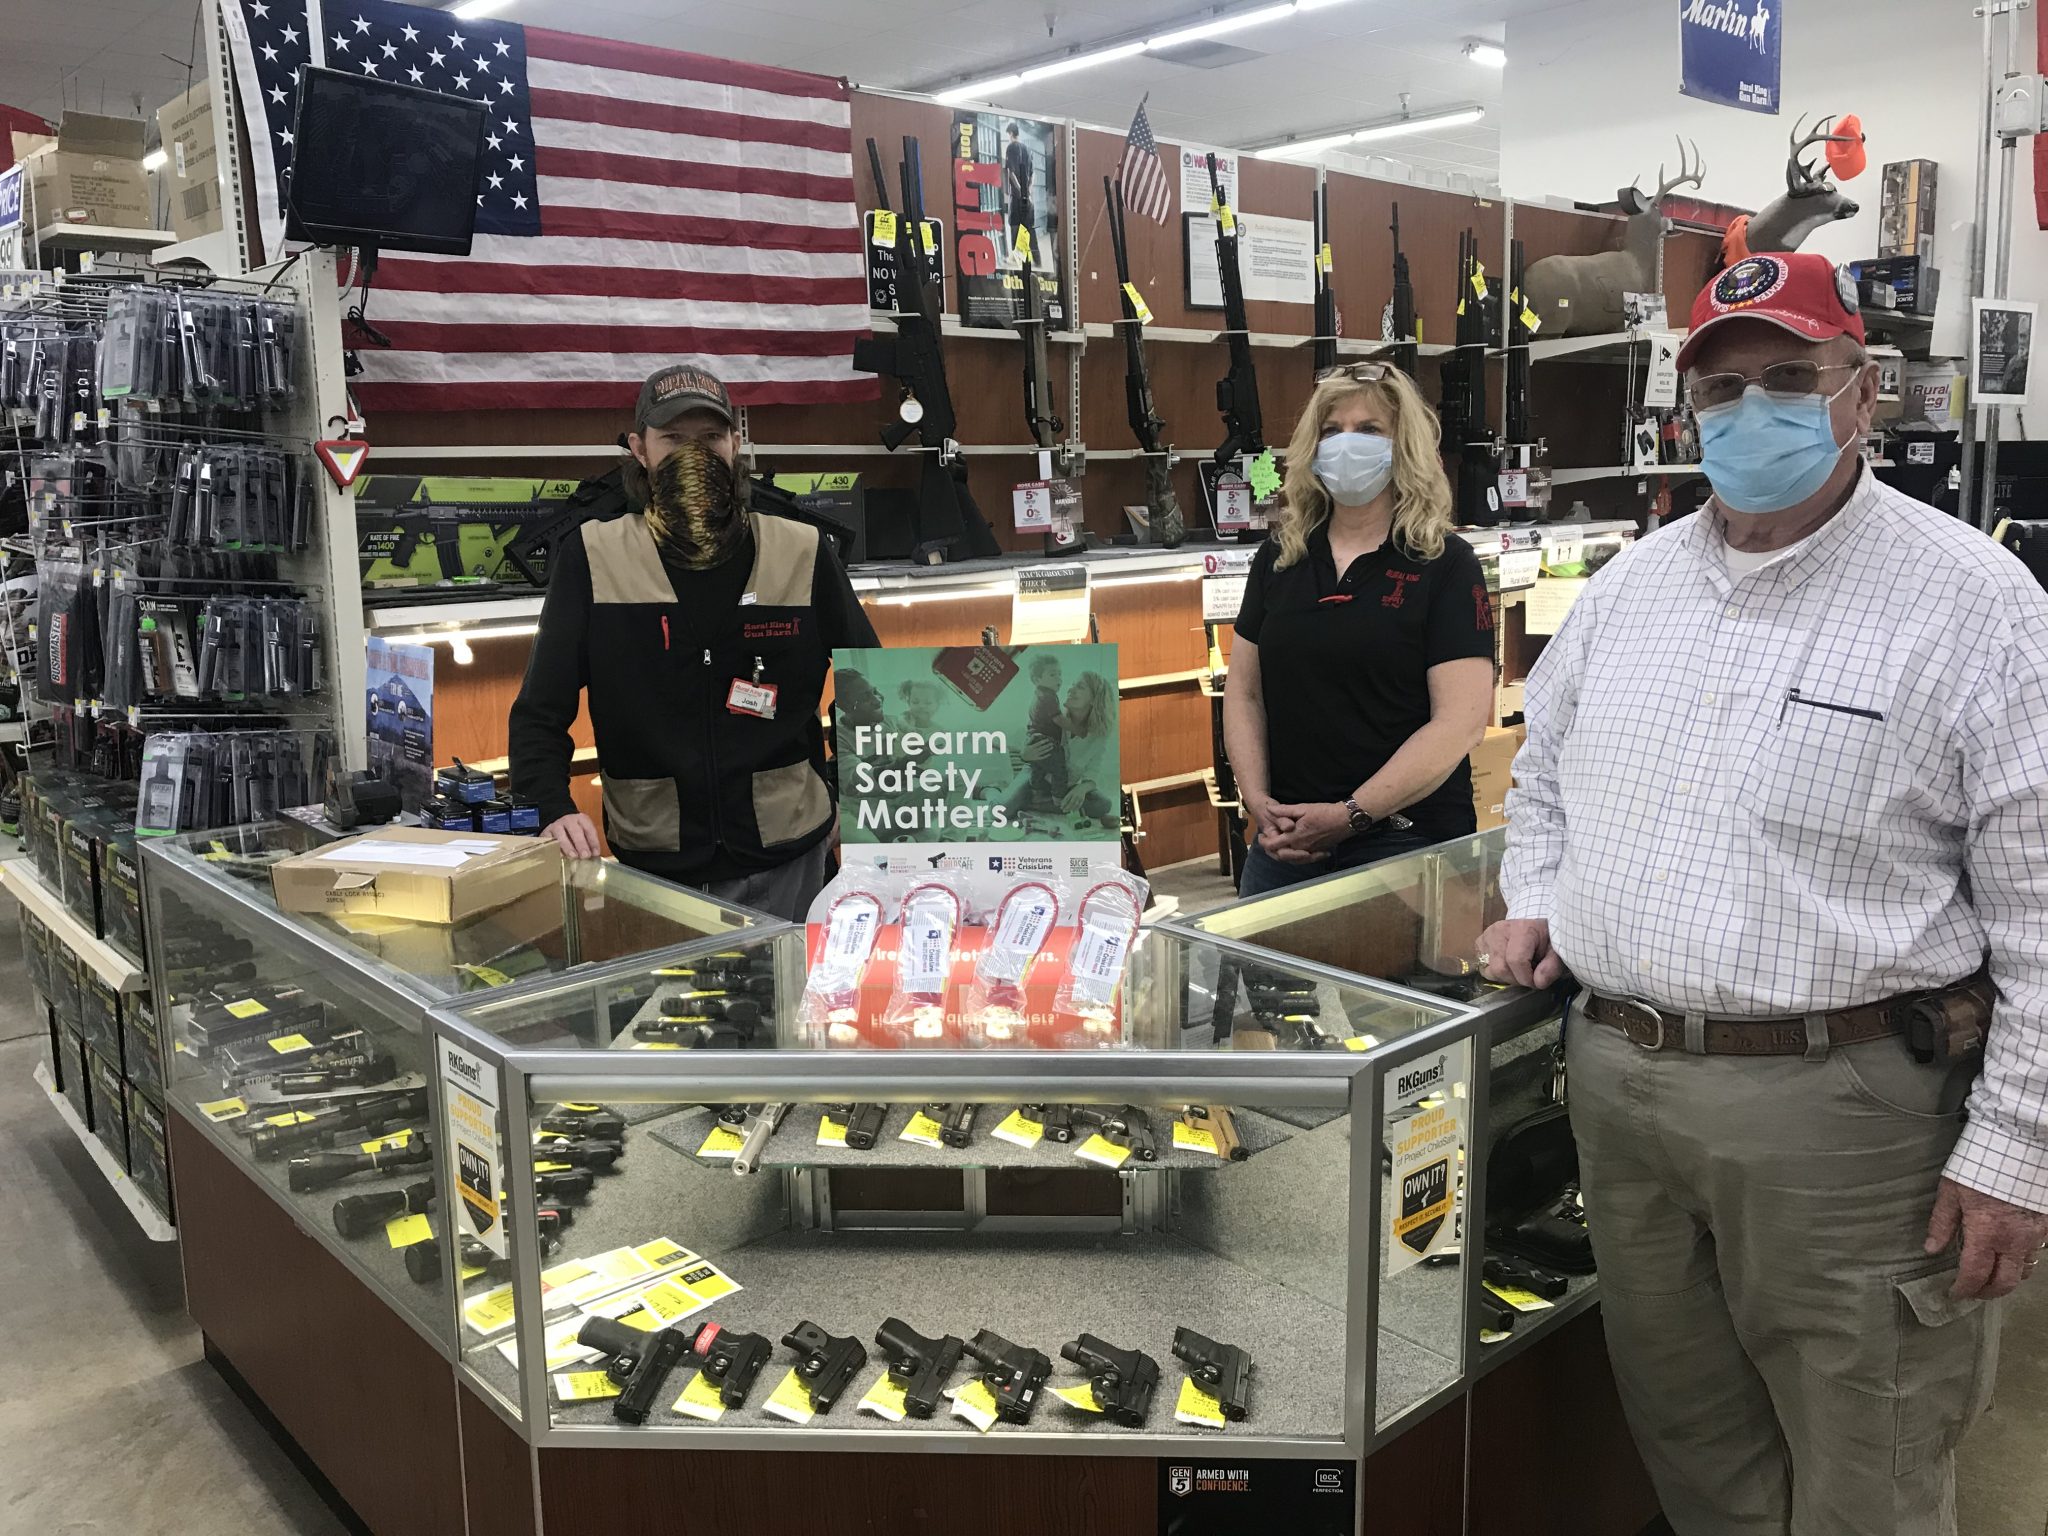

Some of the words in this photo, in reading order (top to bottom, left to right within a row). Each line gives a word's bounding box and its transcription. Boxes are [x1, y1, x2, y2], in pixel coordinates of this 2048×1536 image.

[1682, 0, 1748, 38] Marlin
[1739, 81, 1754, 94] Rural
[1754, 84, 1768, 98] King
[1738, 91, 1751, 103] Gun
[1752, 94, 1768, 106] Barn
[872, 267, 889, 280] NO
[1913, 383, 1951, 396] Rural
[1925, 396, 1944, 408] ing
[831, 475, 849, 485] 430
[554, 483, 571, 494] 430
[376, 541, 395, 550] 1400
[1018, 569, 1075, 579] BACKGROUND
[1019, 579, 1048, 588] CHECK
[769, 620, 792, 630] King
[743, 630, 764, 639] Gun
[765, 628, 792, 638] Barn
[51, 613, 62, 683] BUSHMASTER
[741, 697, 758, 707] Josh
[854, 725, 1008, 756] Firearm
[855, 760, 983, 800] Safety
[855, 799, 1021, 830] Matters.
[1037, 863, 1053, 871] Line
[1022, 923, 1033, 935] Crisis
[1018, 934, 1028, 946] Line
[1100, 952, 1109, 965] Crisis
[447, 1050, 477, 1082] RKGuns
[1397, 1065, 1440, 1095] RKGuns
[457, 1092, 484, 1118] PROUD
[450, 1103, 494, 1139] SUPPORTER
[1410, 1107, 1446, 1133] PROUD
[1396, 1118, 1457, 1156] SUPPORTER
[1396, 1158, 1404, 1168] of
[1403, 1148, 1427, 1164] Project
[459, 1147, 478, 1173] OWN
[477, 1158, 490, 1183] IT?
[1404, 1170, 1430, 1199] OWN
[1430, 1163, 1446, 1188] IT?
[1398, 1218, 1418, 1231] RESPECT
[1424, 1205, 1440, 1221] SECURE
[1171, 1468, 1191, 1477] GEN
[1196, 1469, 1225, 1480] ARMED
[1227, 1469, 1249, 1480] WITH
[1174, 1478, 1188, 1492] 5
[1196, 1479, 1252, 1492] CONFIDENCE.
